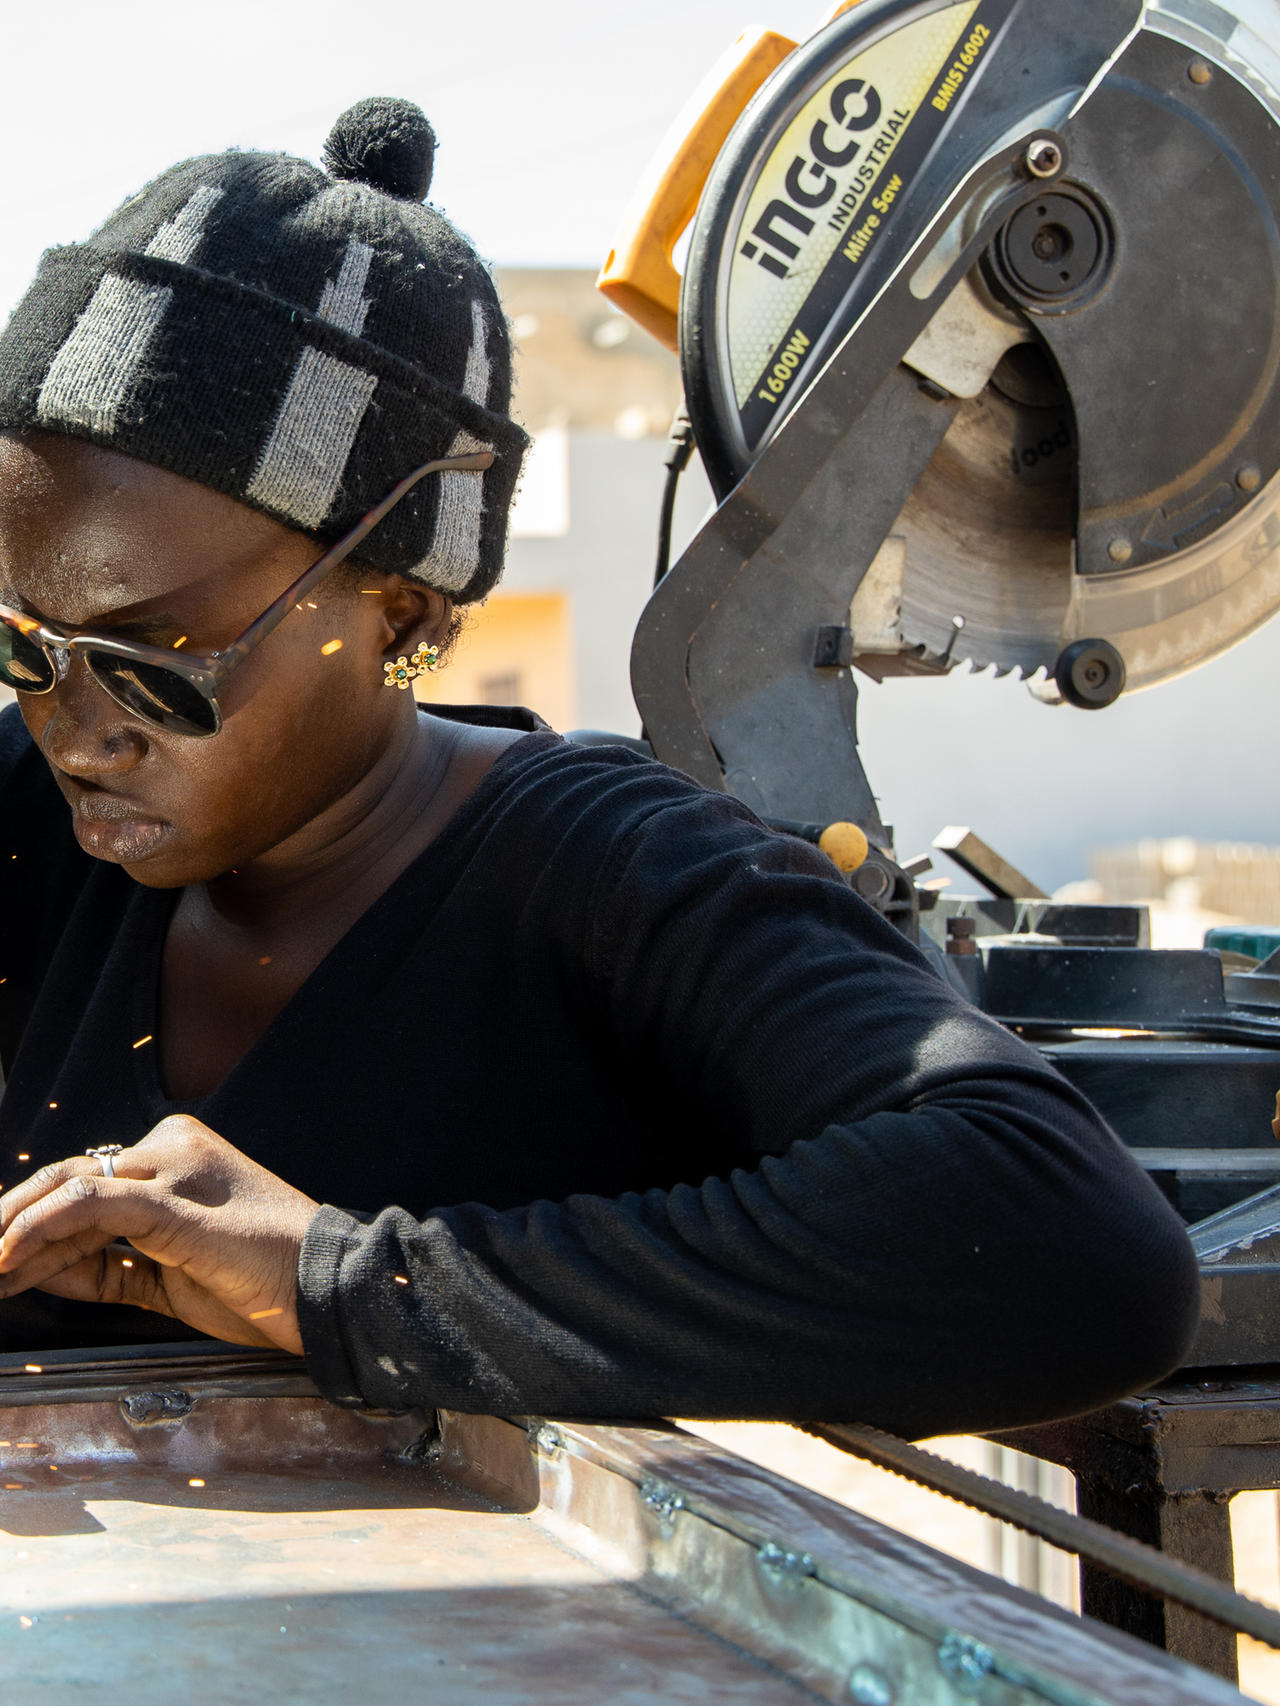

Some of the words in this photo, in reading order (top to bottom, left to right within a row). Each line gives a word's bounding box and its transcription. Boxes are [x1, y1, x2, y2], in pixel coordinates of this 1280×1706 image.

[931, 23, 991, 112] BMIS16002
[827, 109, 911, 232] INDUSTRIAL
[842, 214, 880, 263] Mitre
[871, 173, 903, 214] Saw
[758, 328, 811, 404] 1600W
